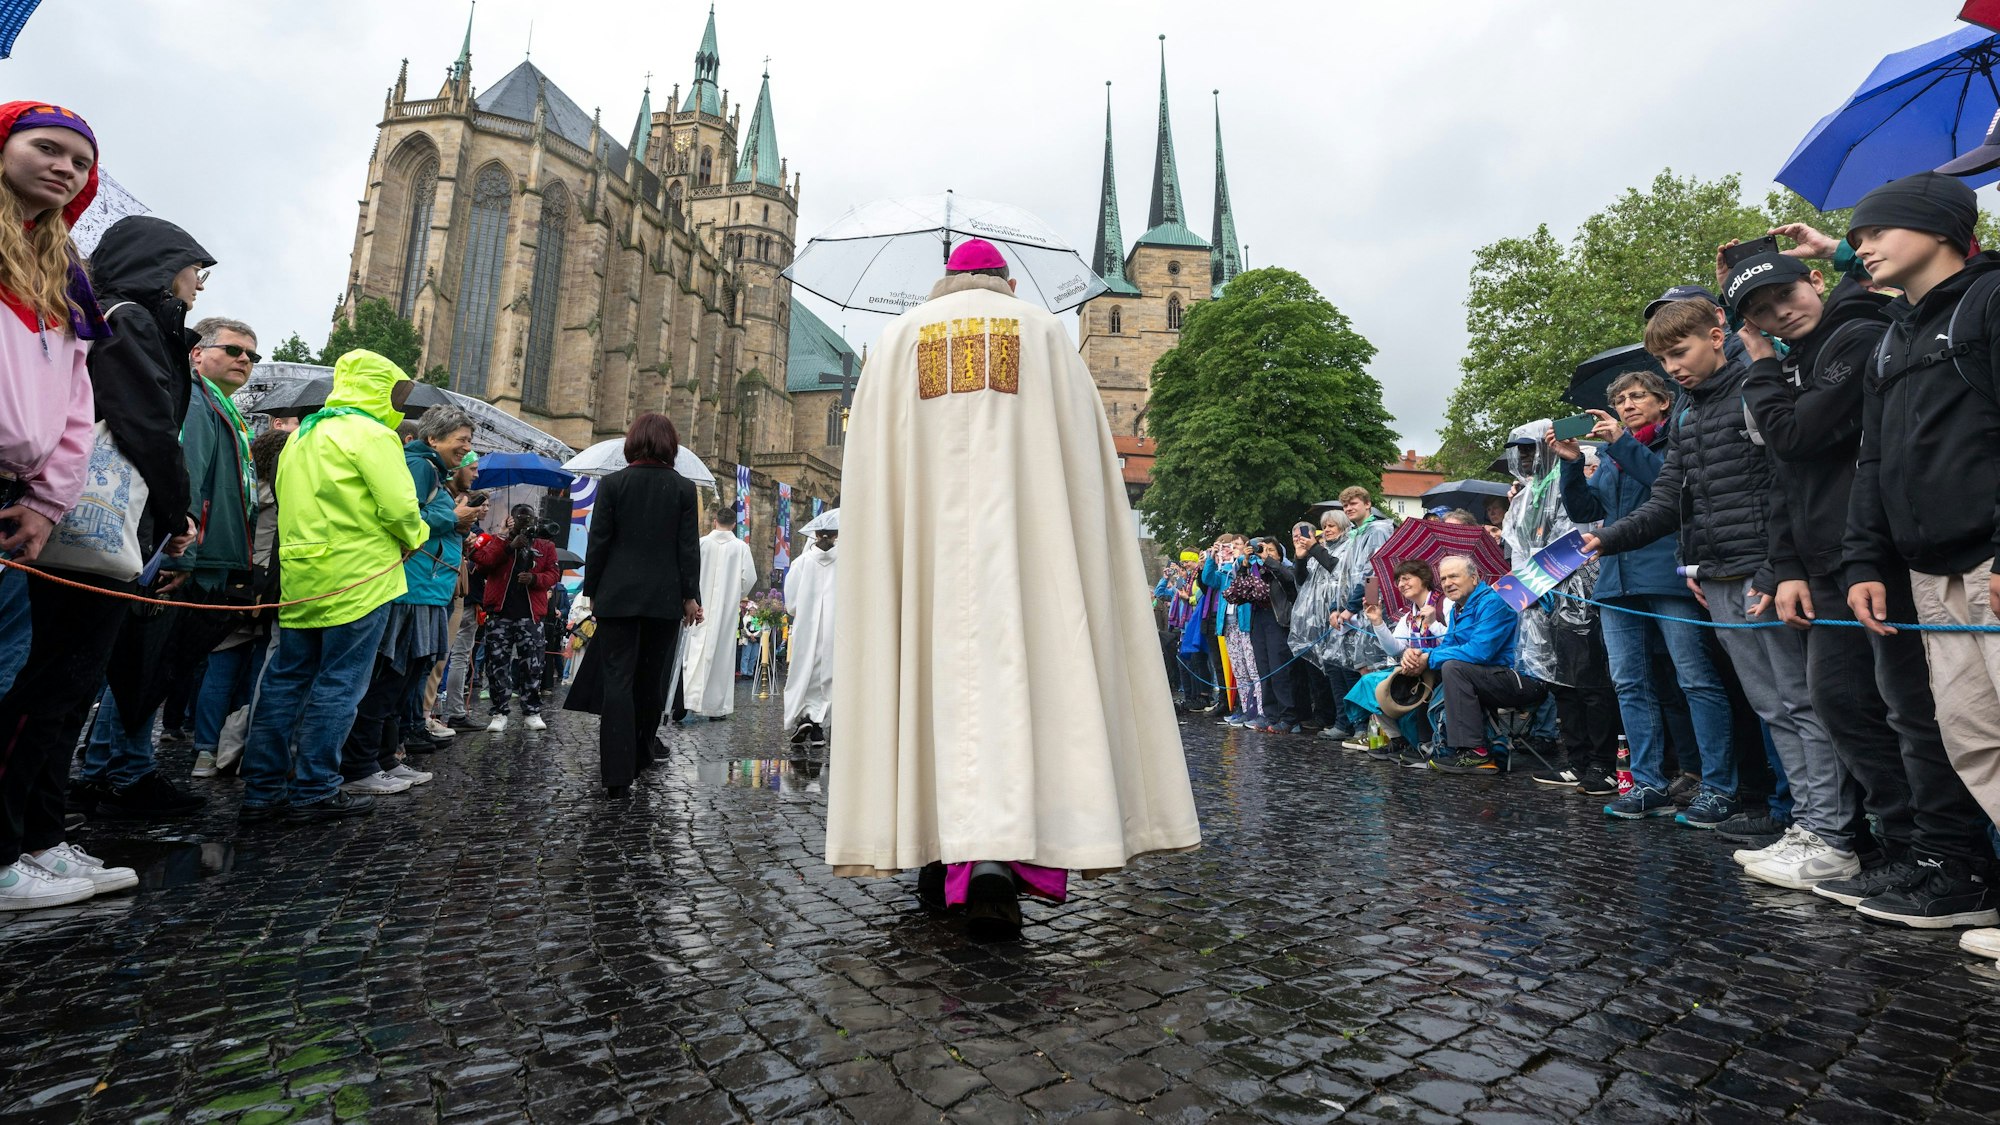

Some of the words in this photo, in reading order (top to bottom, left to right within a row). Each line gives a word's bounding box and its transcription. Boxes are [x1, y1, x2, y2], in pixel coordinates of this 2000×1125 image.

[969, 218, 1021, 233] Deutscher
[971, 223, 1047, 243] Katholikentag
[1728, 262, 1773, 298] adidas
